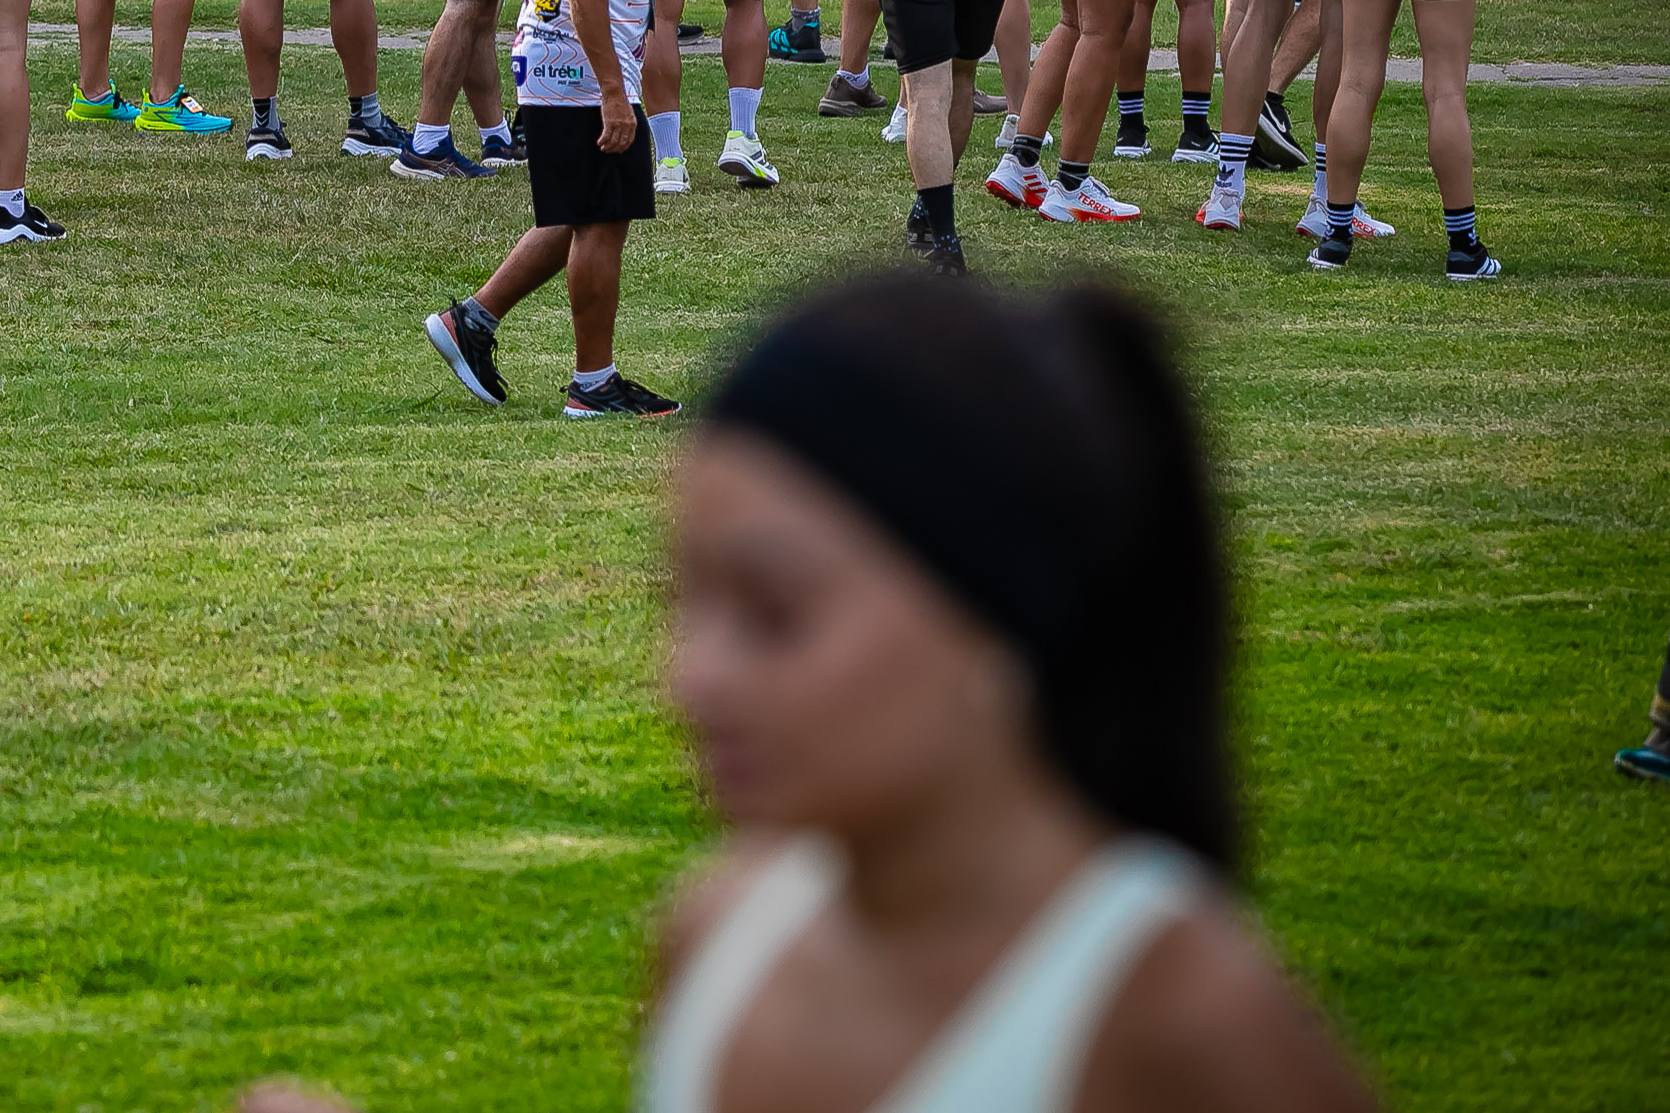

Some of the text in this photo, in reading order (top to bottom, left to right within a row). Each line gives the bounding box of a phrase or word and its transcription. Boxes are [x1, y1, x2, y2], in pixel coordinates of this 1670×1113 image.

[534, 65, 584, 79] el trébol
[1078, 191, 1113, 216] TERREX
[1352, 217, 1375, 235] RREX
